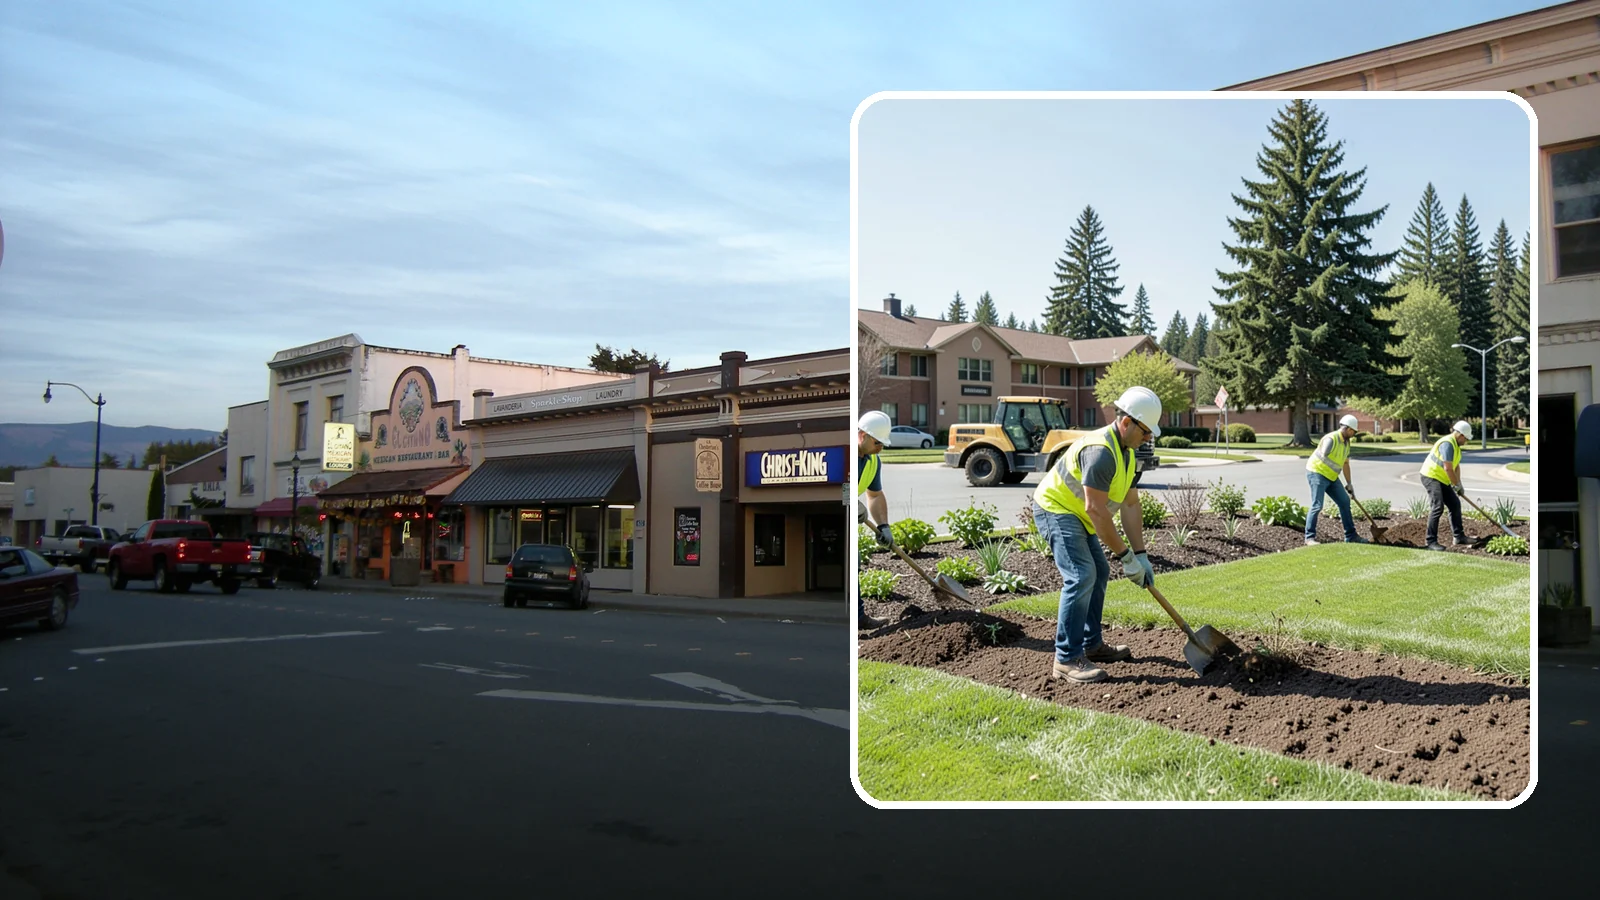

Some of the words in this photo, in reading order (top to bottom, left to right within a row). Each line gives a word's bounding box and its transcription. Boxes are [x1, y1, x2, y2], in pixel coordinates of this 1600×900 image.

[595, 389, 624, 400] LAUNDRY
[494, 402, 522, 412] LAVANDERIA
[374, 455, 396, 464] MEXICAN
[397, 451, 433, 463] RESTAURANT
[438, 450, 450, 459] BAR
[761, 452, 797, 477] CHRIST
[799, 450, 827, 476] KING
